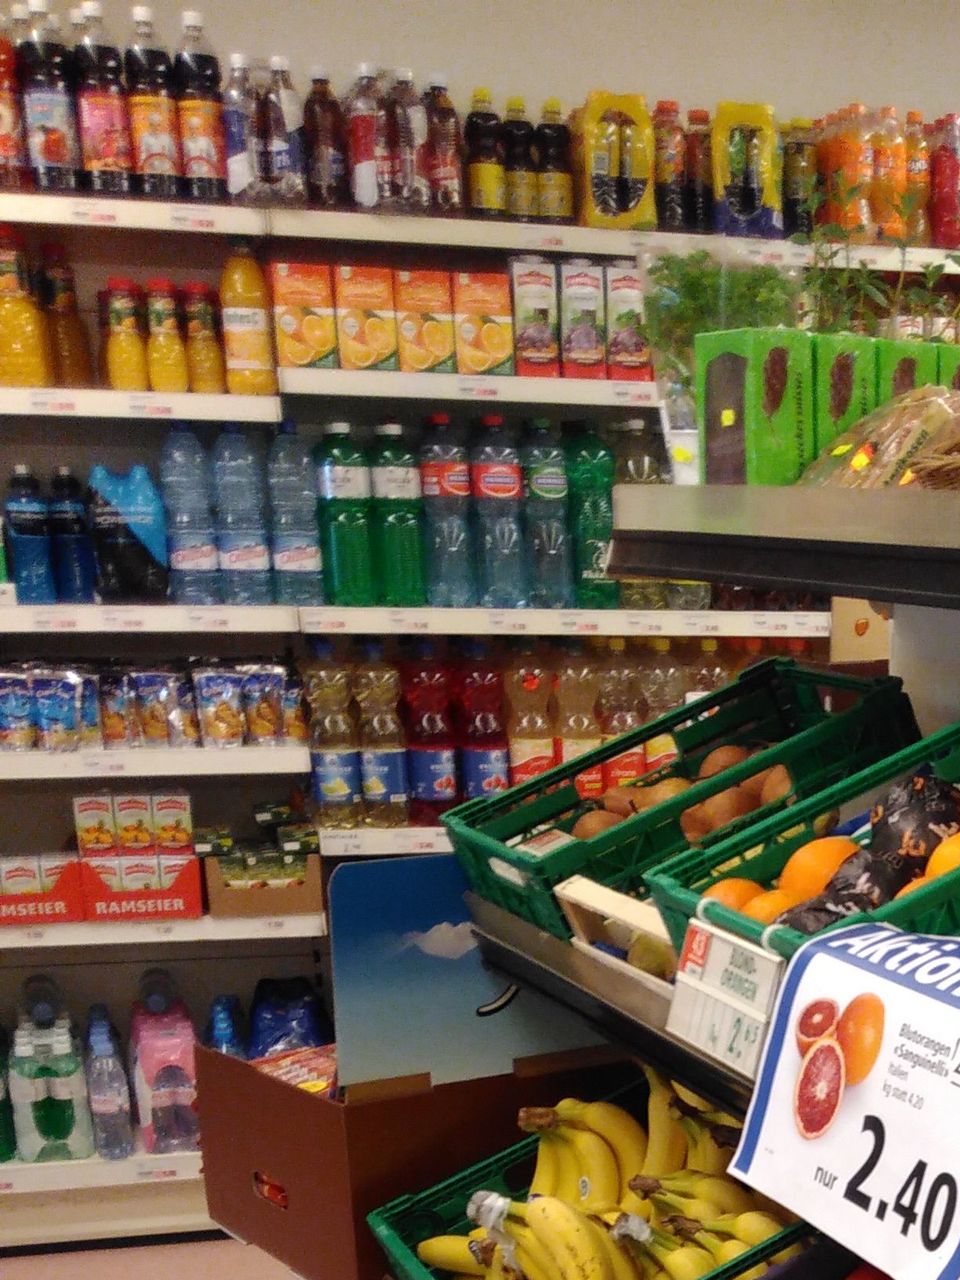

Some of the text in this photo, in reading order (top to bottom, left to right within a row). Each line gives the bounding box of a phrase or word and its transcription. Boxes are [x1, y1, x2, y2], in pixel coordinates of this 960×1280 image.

[0, 901, 67, 918] MSEIER
[95, 898, 185, 915] RAMSEIER
[899, 1022, 951, 1058] Blutorangen
[814, 1114, 957, 1252] nur 2.40
